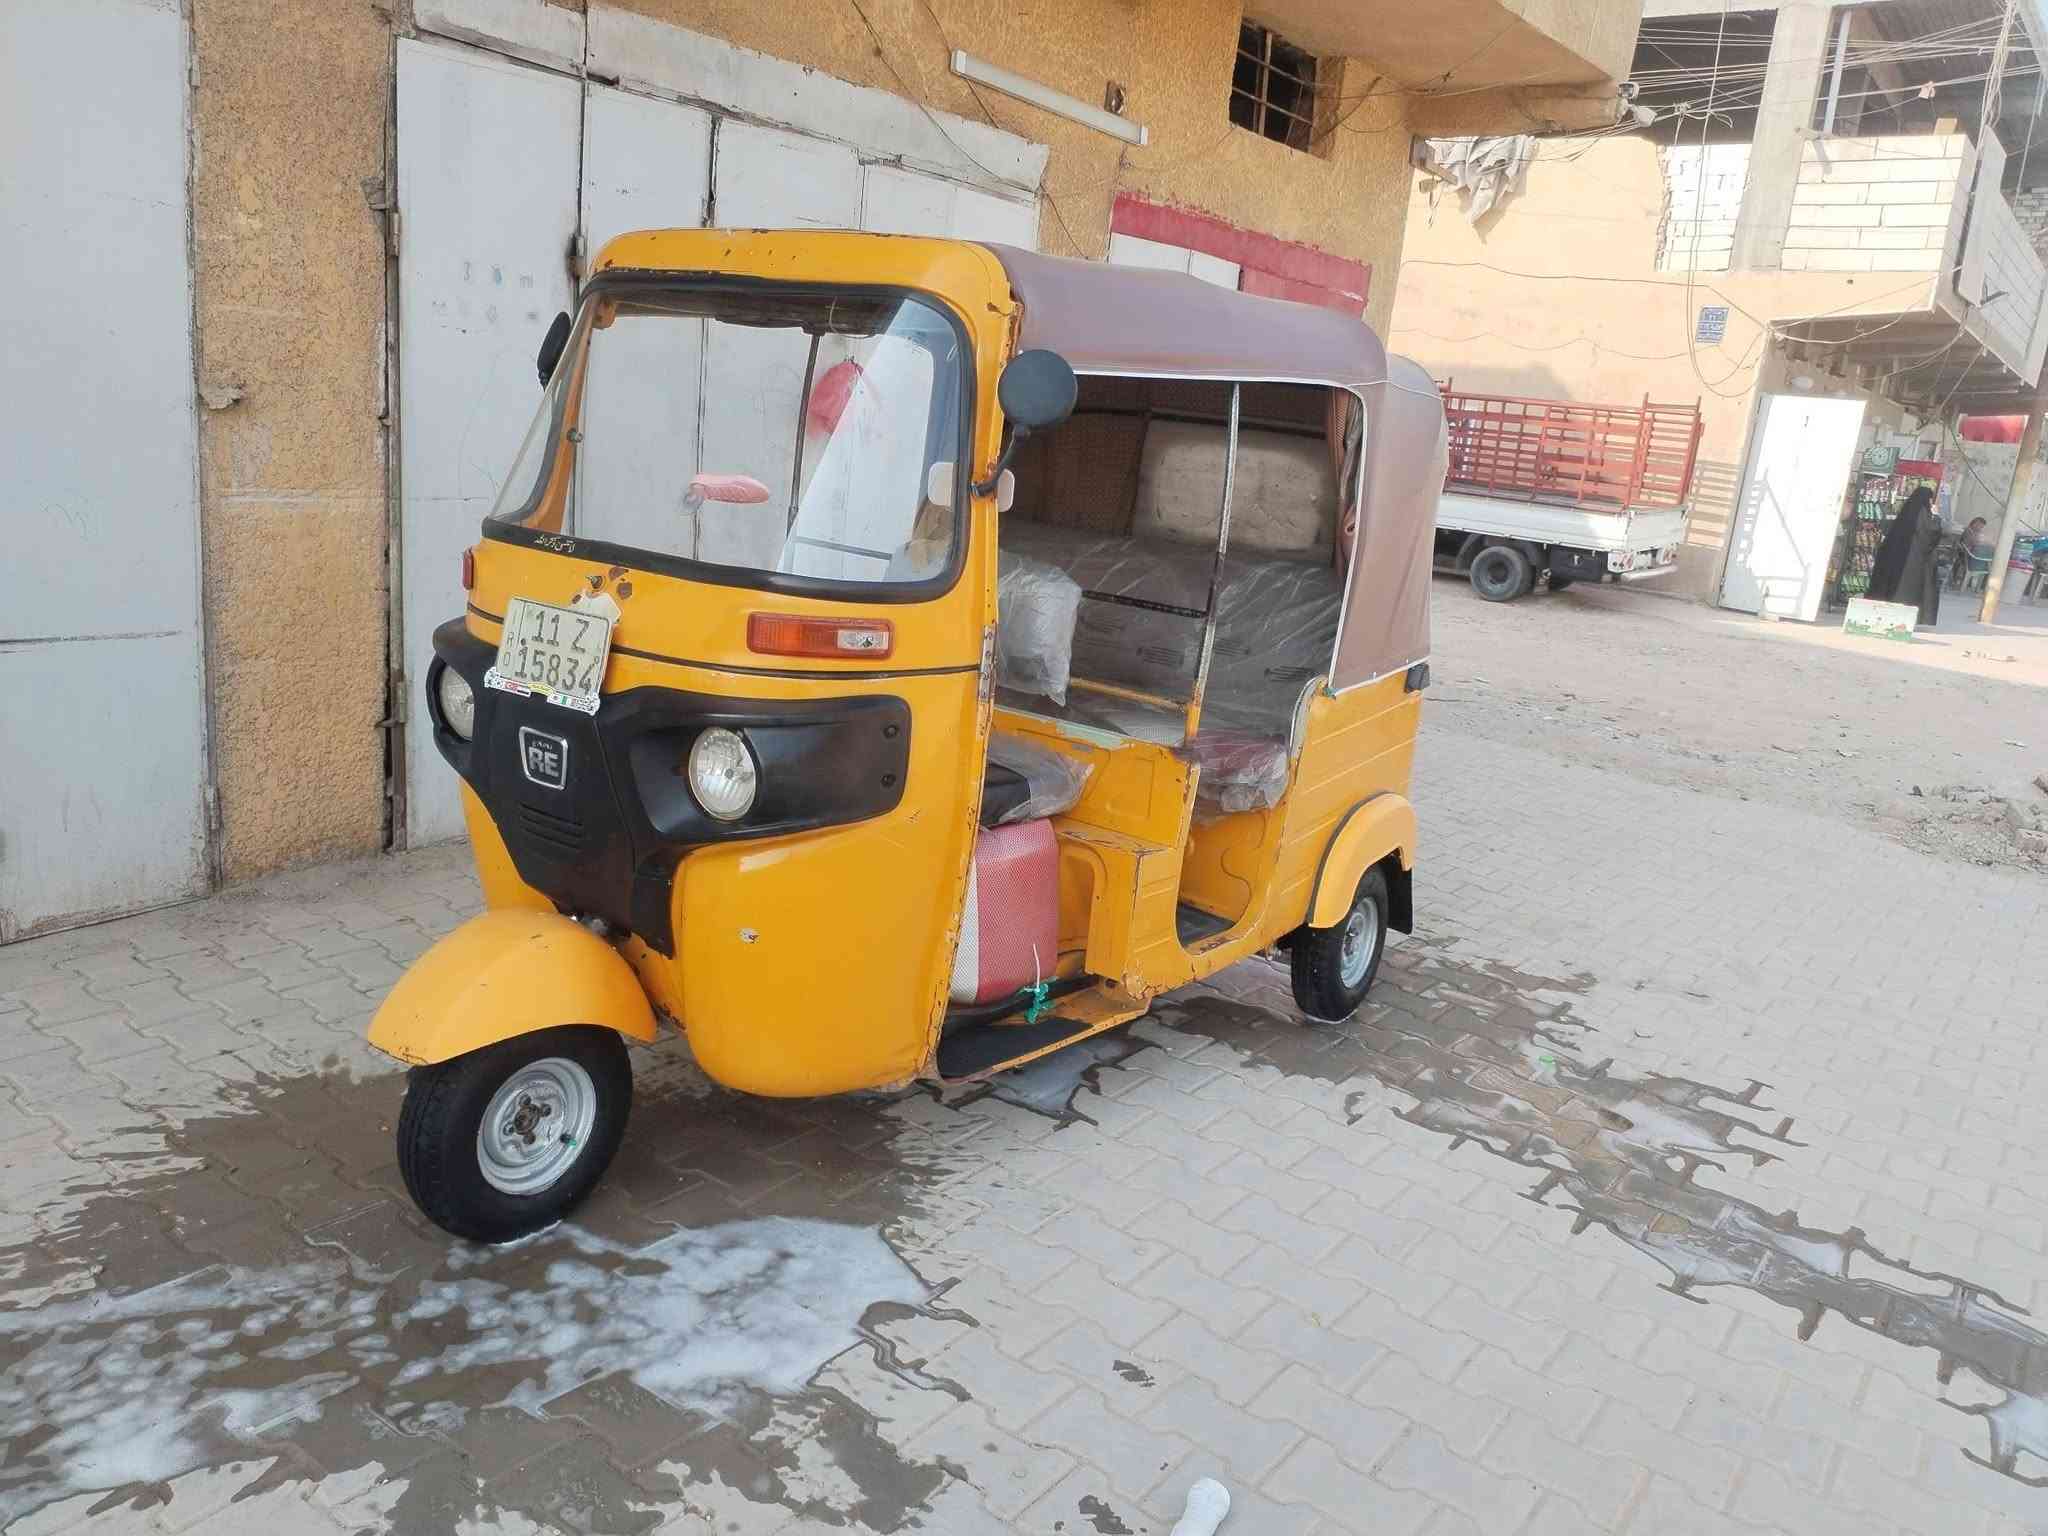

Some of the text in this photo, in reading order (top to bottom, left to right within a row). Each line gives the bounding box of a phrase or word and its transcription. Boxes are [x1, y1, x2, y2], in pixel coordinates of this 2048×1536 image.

[531, 609, 560, 648] 11
[514, 646, 598, 695] 15834
[528, 746, 560, 778] RE
